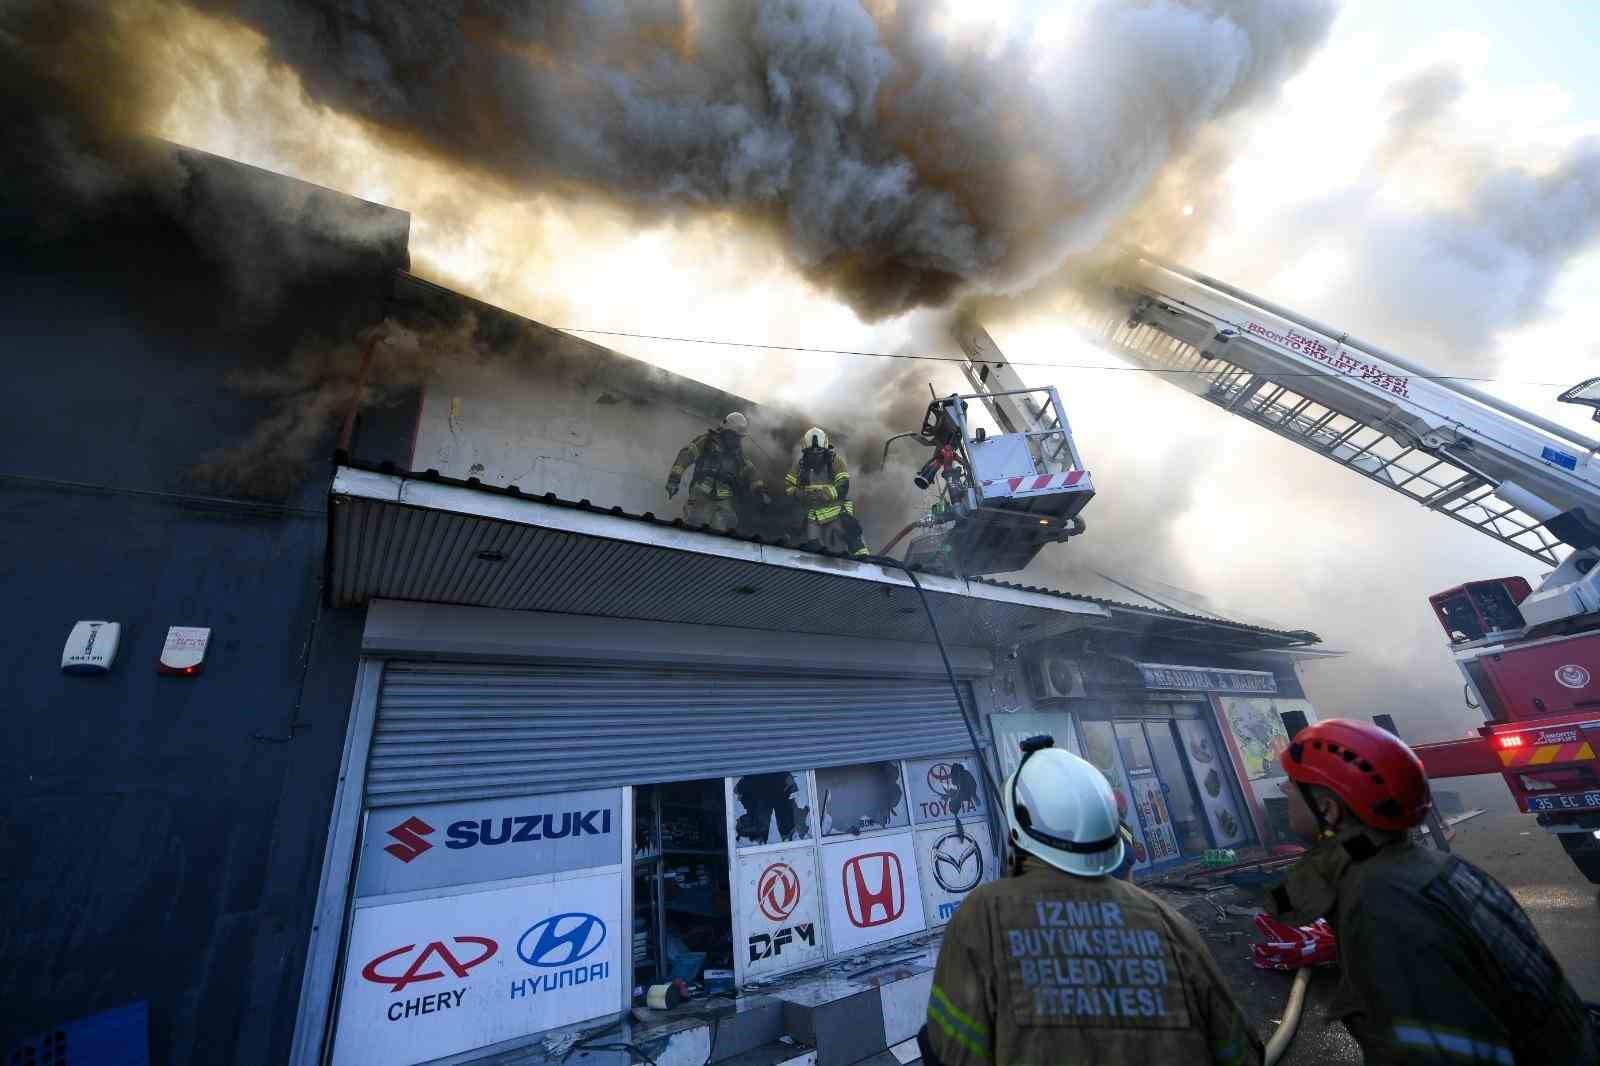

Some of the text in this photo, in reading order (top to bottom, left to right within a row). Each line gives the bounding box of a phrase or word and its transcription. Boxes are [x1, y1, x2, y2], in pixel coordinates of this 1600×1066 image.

[1248, 322, 1301, 350] BRONTO
[1302, 346, 1357, 374] SKYLIFT
[920, 797, 977, 819] TOYTA
[1536, 797, 1554, 809] 35
[445, 809, 611, 850] SUZUKI
[748, 922, 816, 963] DFM
[510, 961, 609, 1000] HYUNDAI
[387, 988, 467, 1022] CHERY
